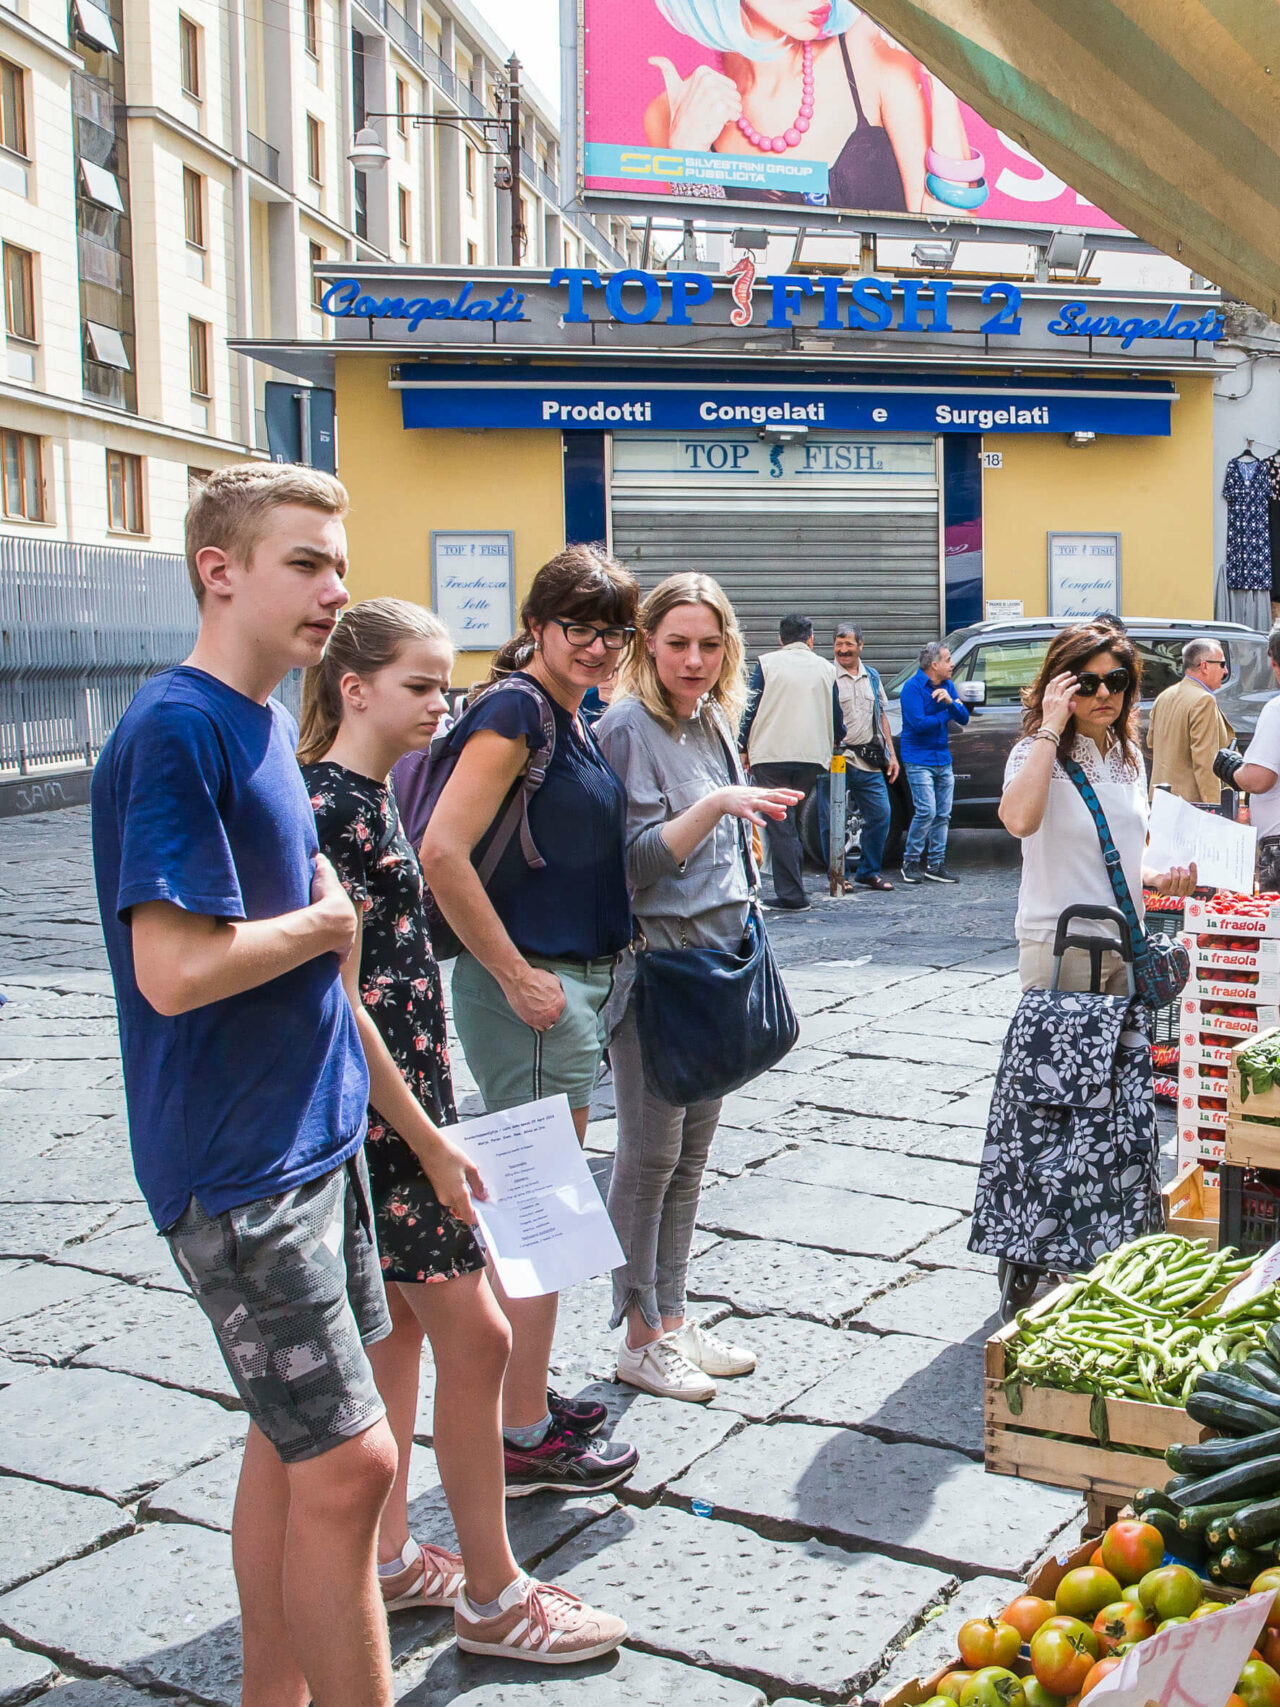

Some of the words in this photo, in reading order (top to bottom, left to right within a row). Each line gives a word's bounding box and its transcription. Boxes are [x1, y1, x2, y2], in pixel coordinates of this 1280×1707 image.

[685, 157, 765, 172] SILVESTRINI
[766, 163, 813, 177] GROUP
[320, 278, 525, 332] Congelati
[550, 268, 713, 326] TOP
[767, 275, 954, 334] FISH
[980, 282, 1023, 336] 2
[1048, 302, 1226, 350] Surgelati
[542, 401, 652, 423] Prodotti
[699, 402, 825, 427] Congelati
[872, 406, 888, 423] e
[935, 404, 1050, 429] Surgelati
[686, 444, 750, 469] TOP
[802, 446, 876, 470] FISH
[985, 454, 1001, 467] 18
[444, 546, 465, 555] TOP
[481, 546, 506, 556] FISH
[440, 576, 507, 589] Freschezza
[1059, 577, 1114, 592] Congelati
[459, 616, 490, 630] Zero
[1207, 919, 1217, 928] la
[1220, 919, 1266, 932] fragola
[1199, 952, 1209, 962] la
[1211, 952, 1257, 966] fragola
[1199, 985, 1209, 994] la
[1211, 985, 1257, 999] fragola
[1202, 1017, 1211, 1027] la
[1214, 1018, 1258, 1034] fragola
[1202, 1048, 1211, 1058] la
[1201, 1081, 1210, 1090] la
[1200, 1112, 1210, 1122] la
[1200, 1145, 1210, 1154] la
